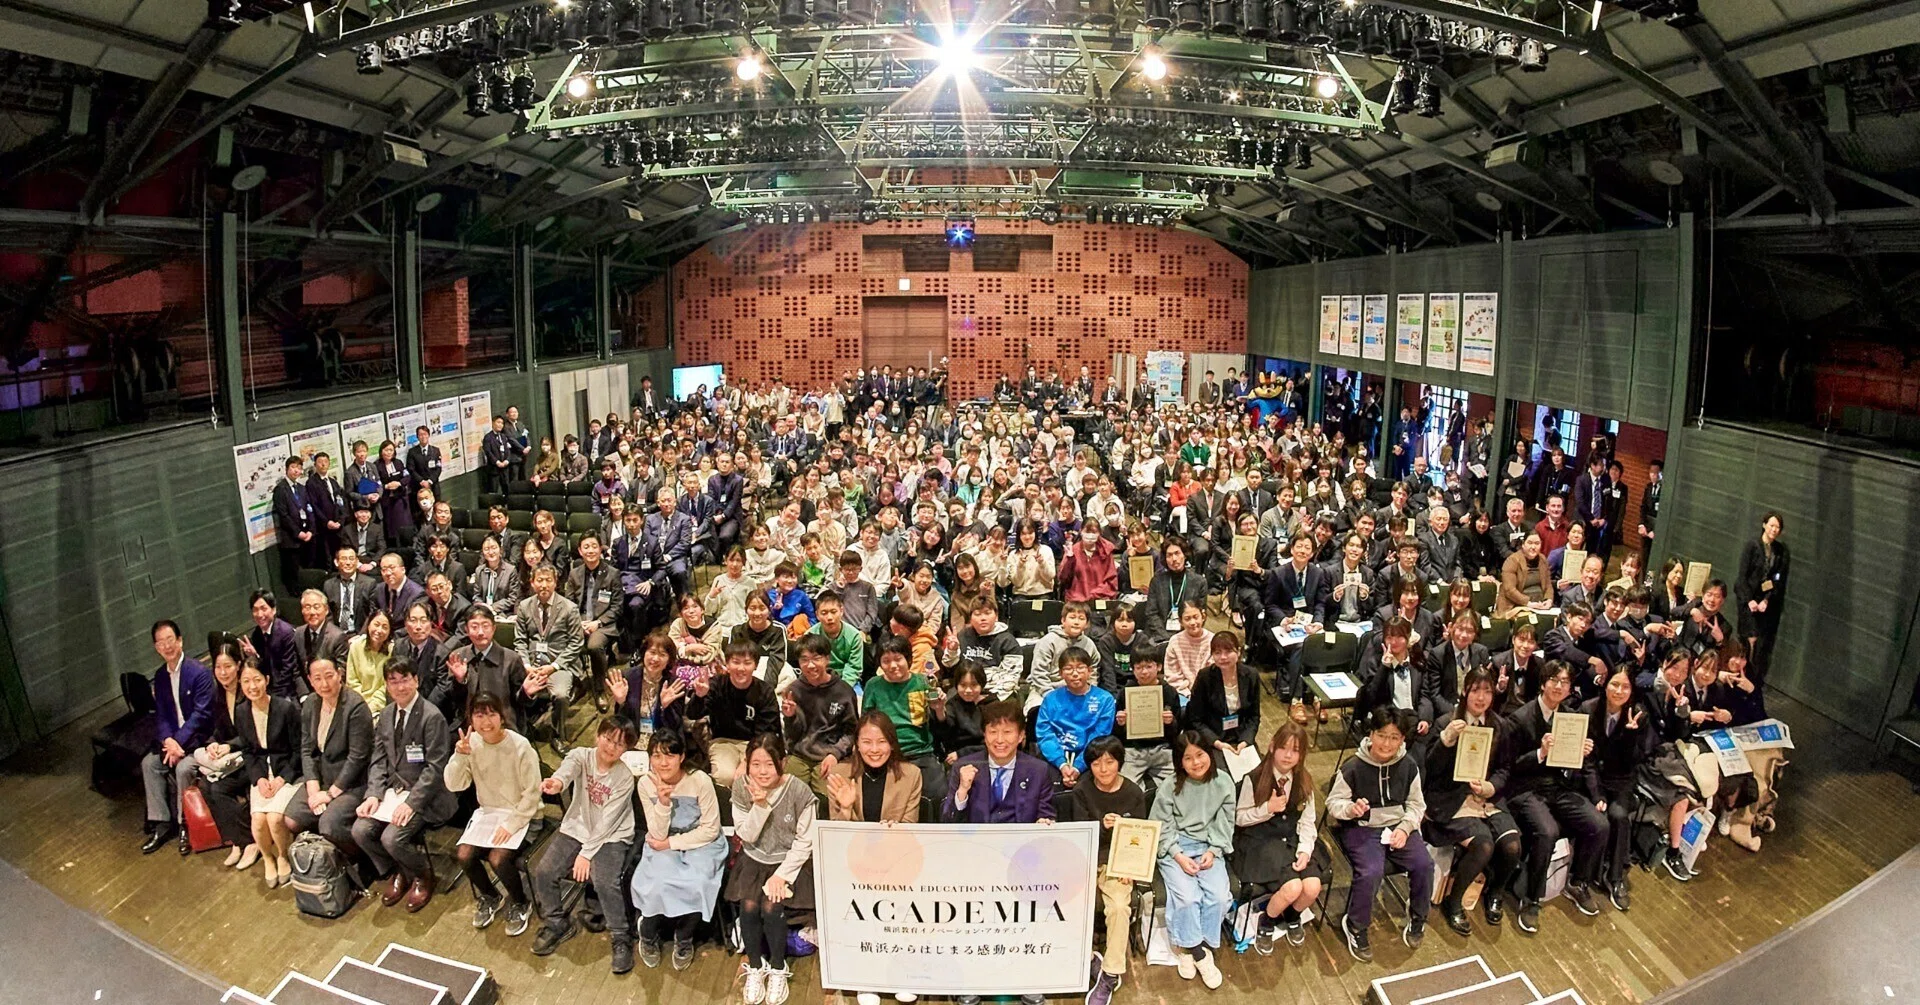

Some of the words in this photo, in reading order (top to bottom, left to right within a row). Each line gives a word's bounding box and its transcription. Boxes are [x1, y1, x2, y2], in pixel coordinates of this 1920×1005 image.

[852, 883, 914, 892] YOKOHAMA
[920, 885, 984, 893] EDUCATION
[991, 883, 1060, 892] INNOVATION
[843, 899, 1067, 923] ACADEMIA
[860, 941, 1051, 956] 横浜からはじまる感動の教育
